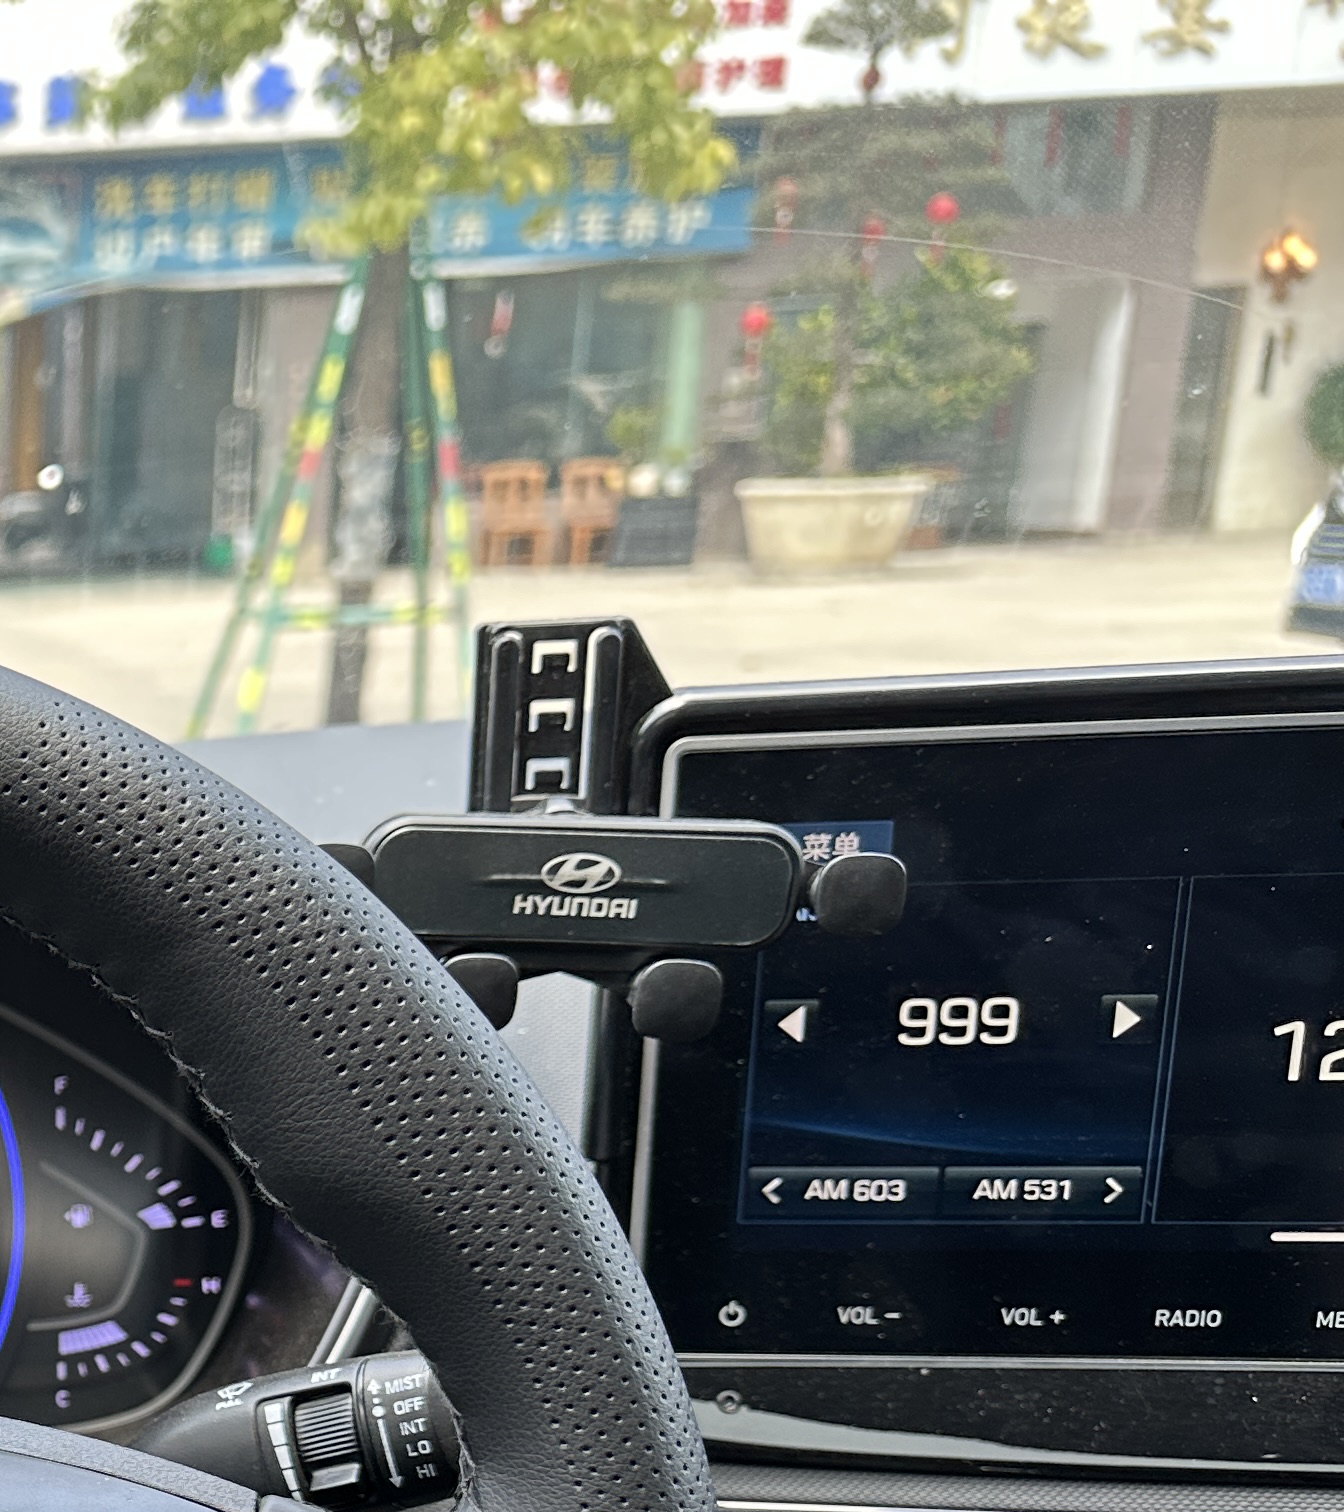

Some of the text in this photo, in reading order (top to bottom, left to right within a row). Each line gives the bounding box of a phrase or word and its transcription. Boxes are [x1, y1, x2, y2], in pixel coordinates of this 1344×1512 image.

[802, 832, 860, 860] 菜单
[513, 895, 638, 919] HYUNDAI
[898, 997, 1019, 1045] 999
[804, 1179, 906, 1201] AM 603
[973, 1179, 1071, 1200] AM 531
[1155, 1310, 1221, 1327] RADIO
[310, 1367, 344, 1384] INT
[384, 1374, 427, 1395] MIST
[392, 1397, 425, 1416] OFF
[400, 1418, 427, 1436] INT
[407, 1440, 432, 1457] LO
[416, 1464, 438, 1479] HI
